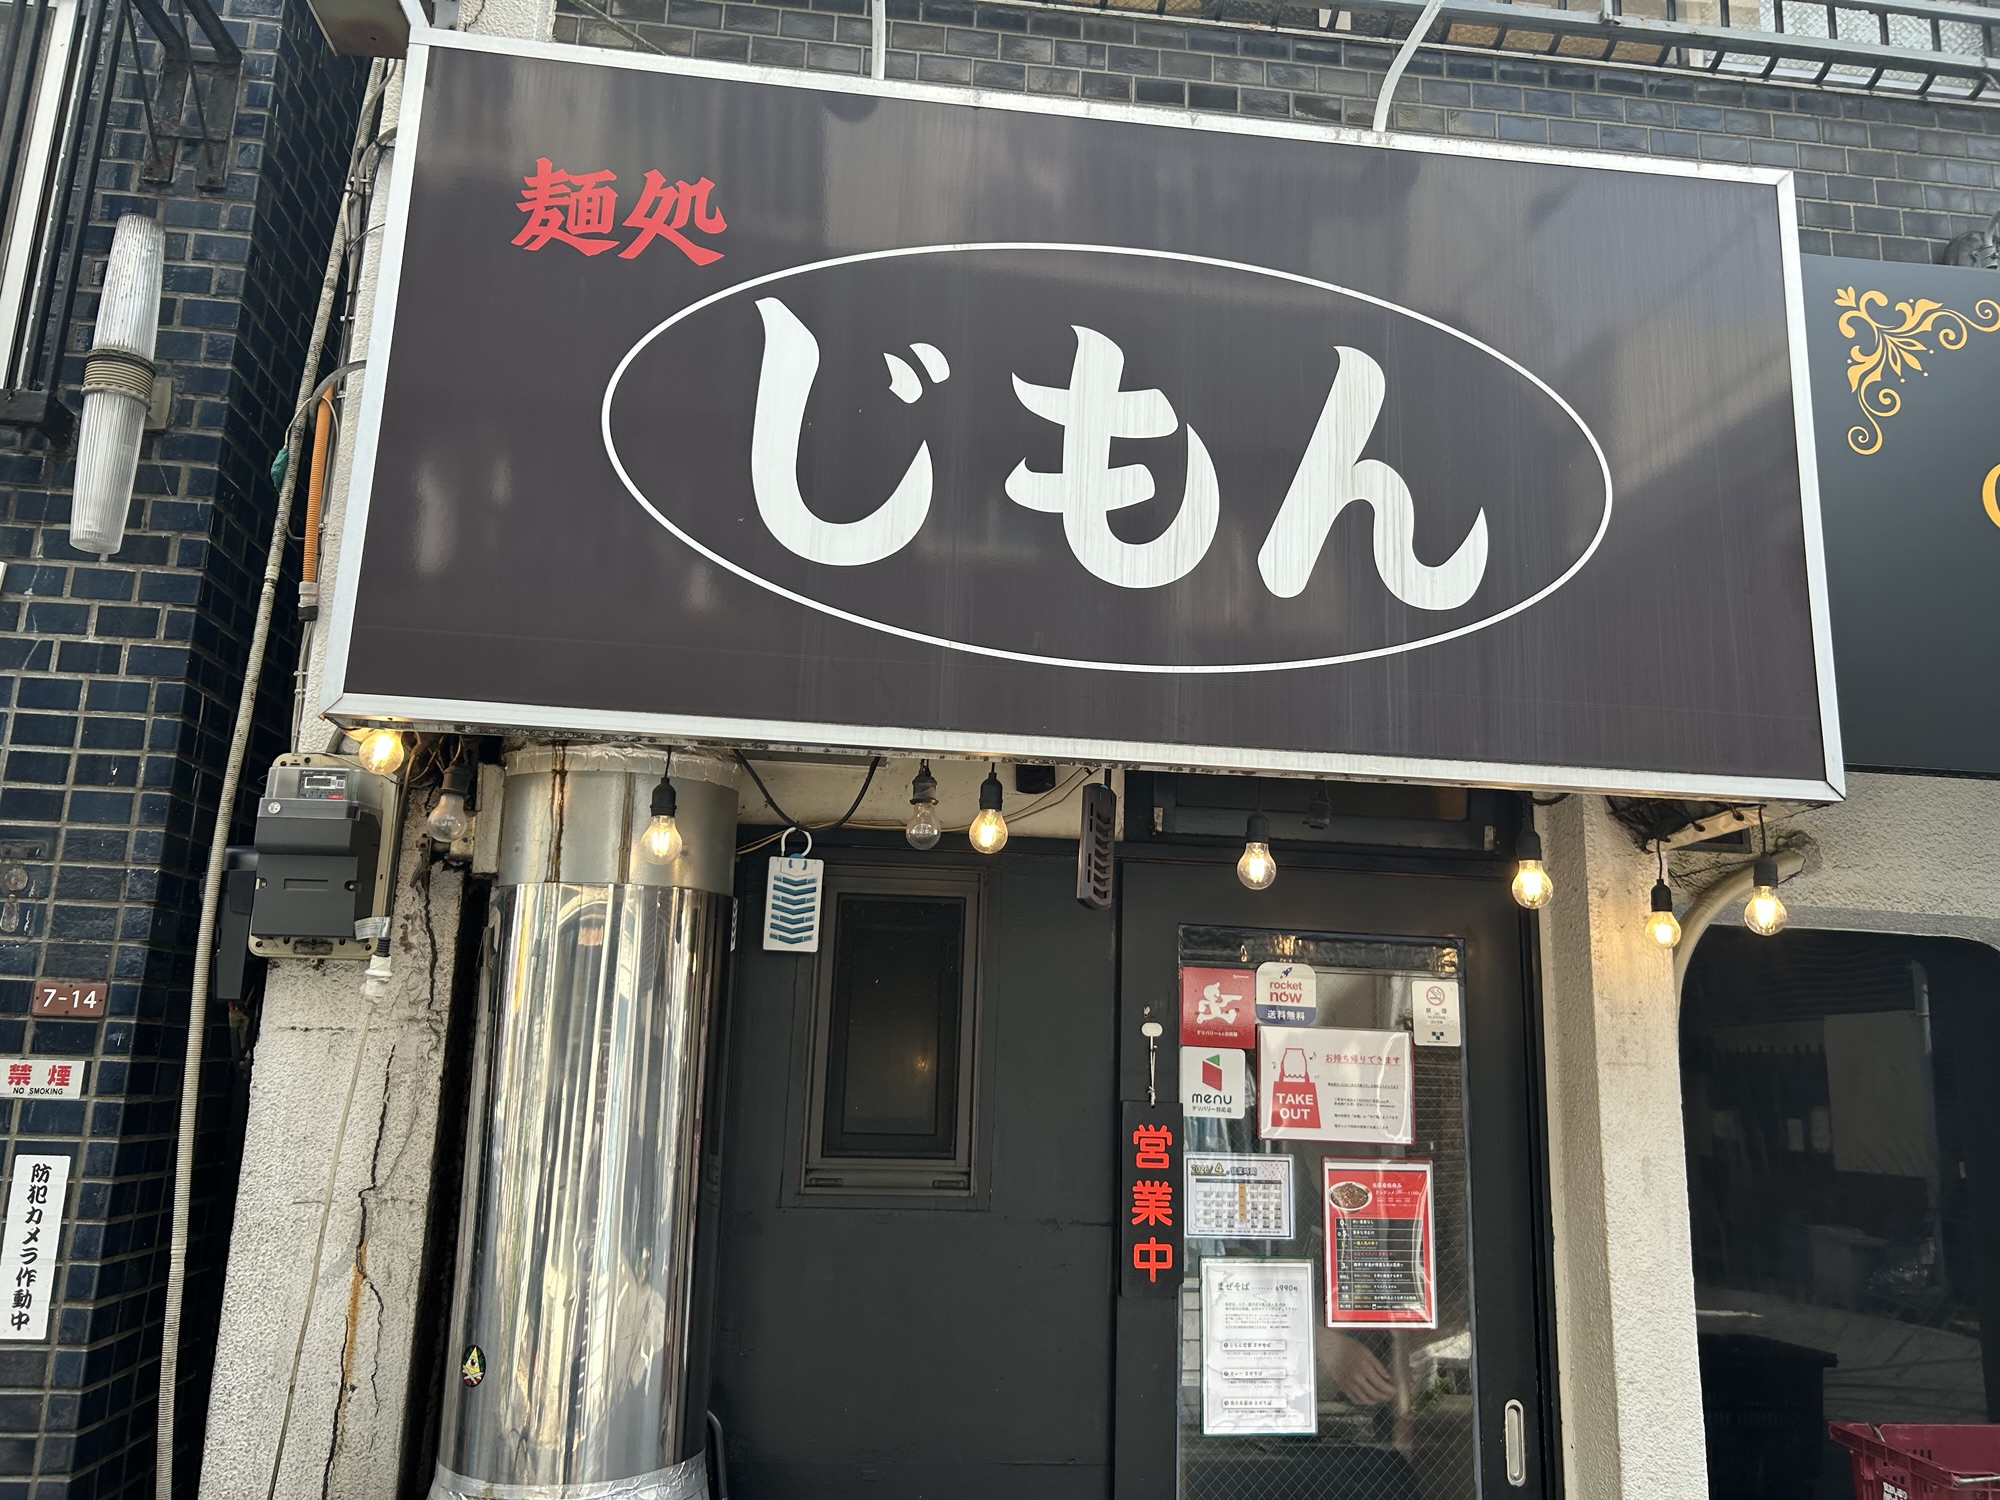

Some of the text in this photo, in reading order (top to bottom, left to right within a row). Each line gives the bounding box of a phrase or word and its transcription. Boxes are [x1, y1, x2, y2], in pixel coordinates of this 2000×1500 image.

[511, 157, 728, 267] 麺処
[750, 296, 1490, 611] じもん
[1269, 980, 1303, 991] rocket
[42, 988, 98, 1010] 7-14
[1269, 991, 1303, 1003] now
[1267, 1009, 1305, 1021] 送料無料
[1324, 1053, 1401, 1065] お持ち帰りできます
[7, 1064, 73, 1087] 禁煙
[12, 1087, 64, 1096] NO SMOKING
[1191, 1093, 1232, 1105] menu
[1275, 1093, 1314, 1106] TAKE
[1191, 1105, 1233, 1114] デリバリー対応店
[1279, 1107, 1312, 1120] OUT
[1131, 1123, 1174, 1283] 営業中
[10, 1162, 52, 1332] 防犯カメラ作動中
[1217, 1281, 1250, 1291] まぜそば
